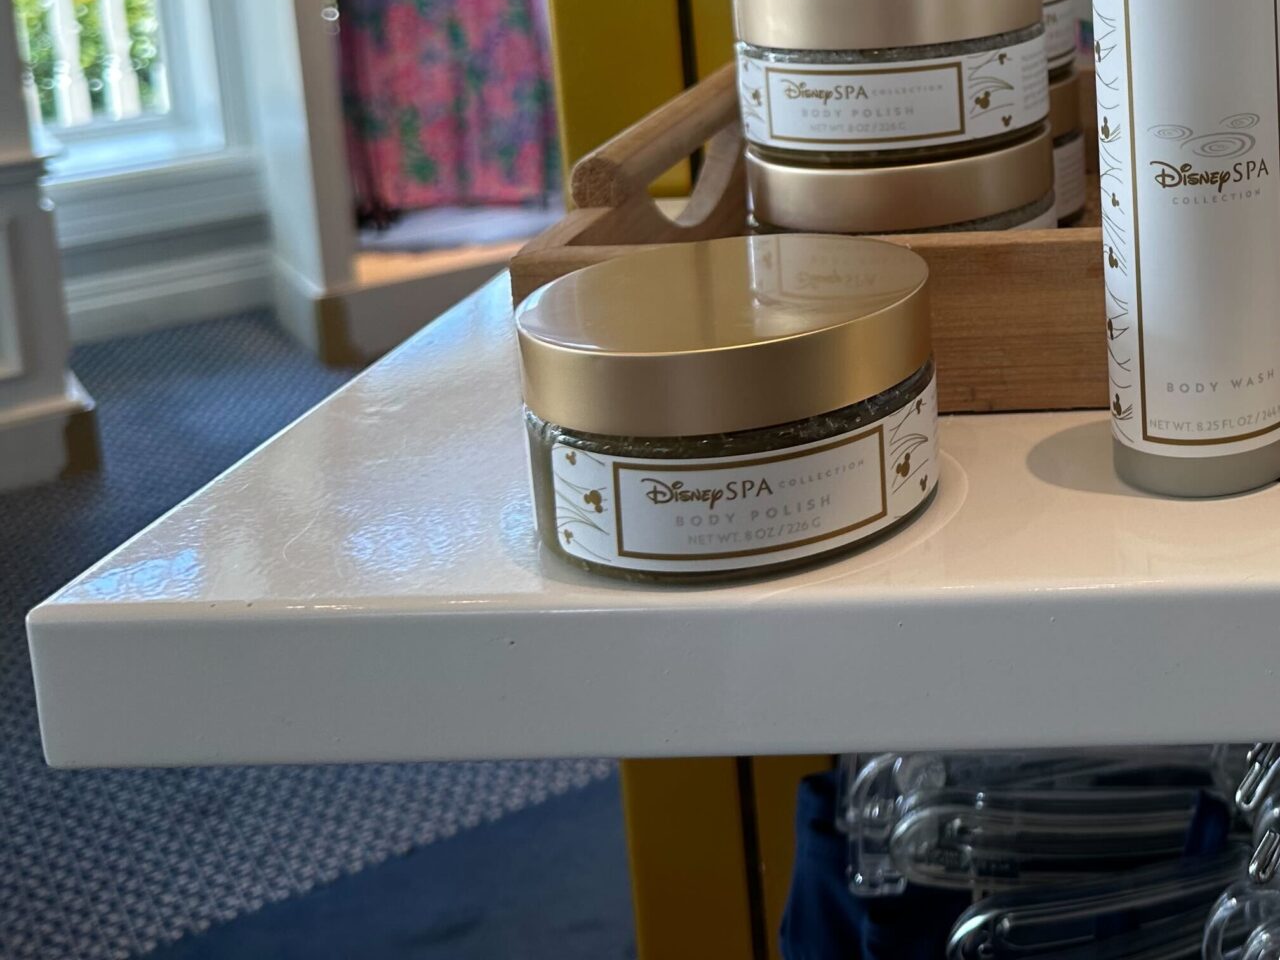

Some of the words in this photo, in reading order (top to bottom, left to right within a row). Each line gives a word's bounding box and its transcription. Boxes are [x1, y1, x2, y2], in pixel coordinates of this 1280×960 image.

[835, 85, 869, 100] SPA
[802, 108, 843, 118] BODY
[852, 106, 915, 118] POLISH
[1149, 160, 1231, 193] Disney
[1233, 158, 1269, 183] SPA
[1172, 188, 1262, 206] COLLECTION
[1166, 381, 1219, 394] BODY
[1231, 369, 1275, 389] WASH
[1149, 419, 1170, 431] NET
[641, 478, 724, 510] Disney
[726, 477, 773, 501] SPA
[778, 459, 865, 489] COLLECTION
[675, 512, 736, 528] BODY
[751, 494, 832, 521] POLISH
[688, 533, 717, 546] NET
